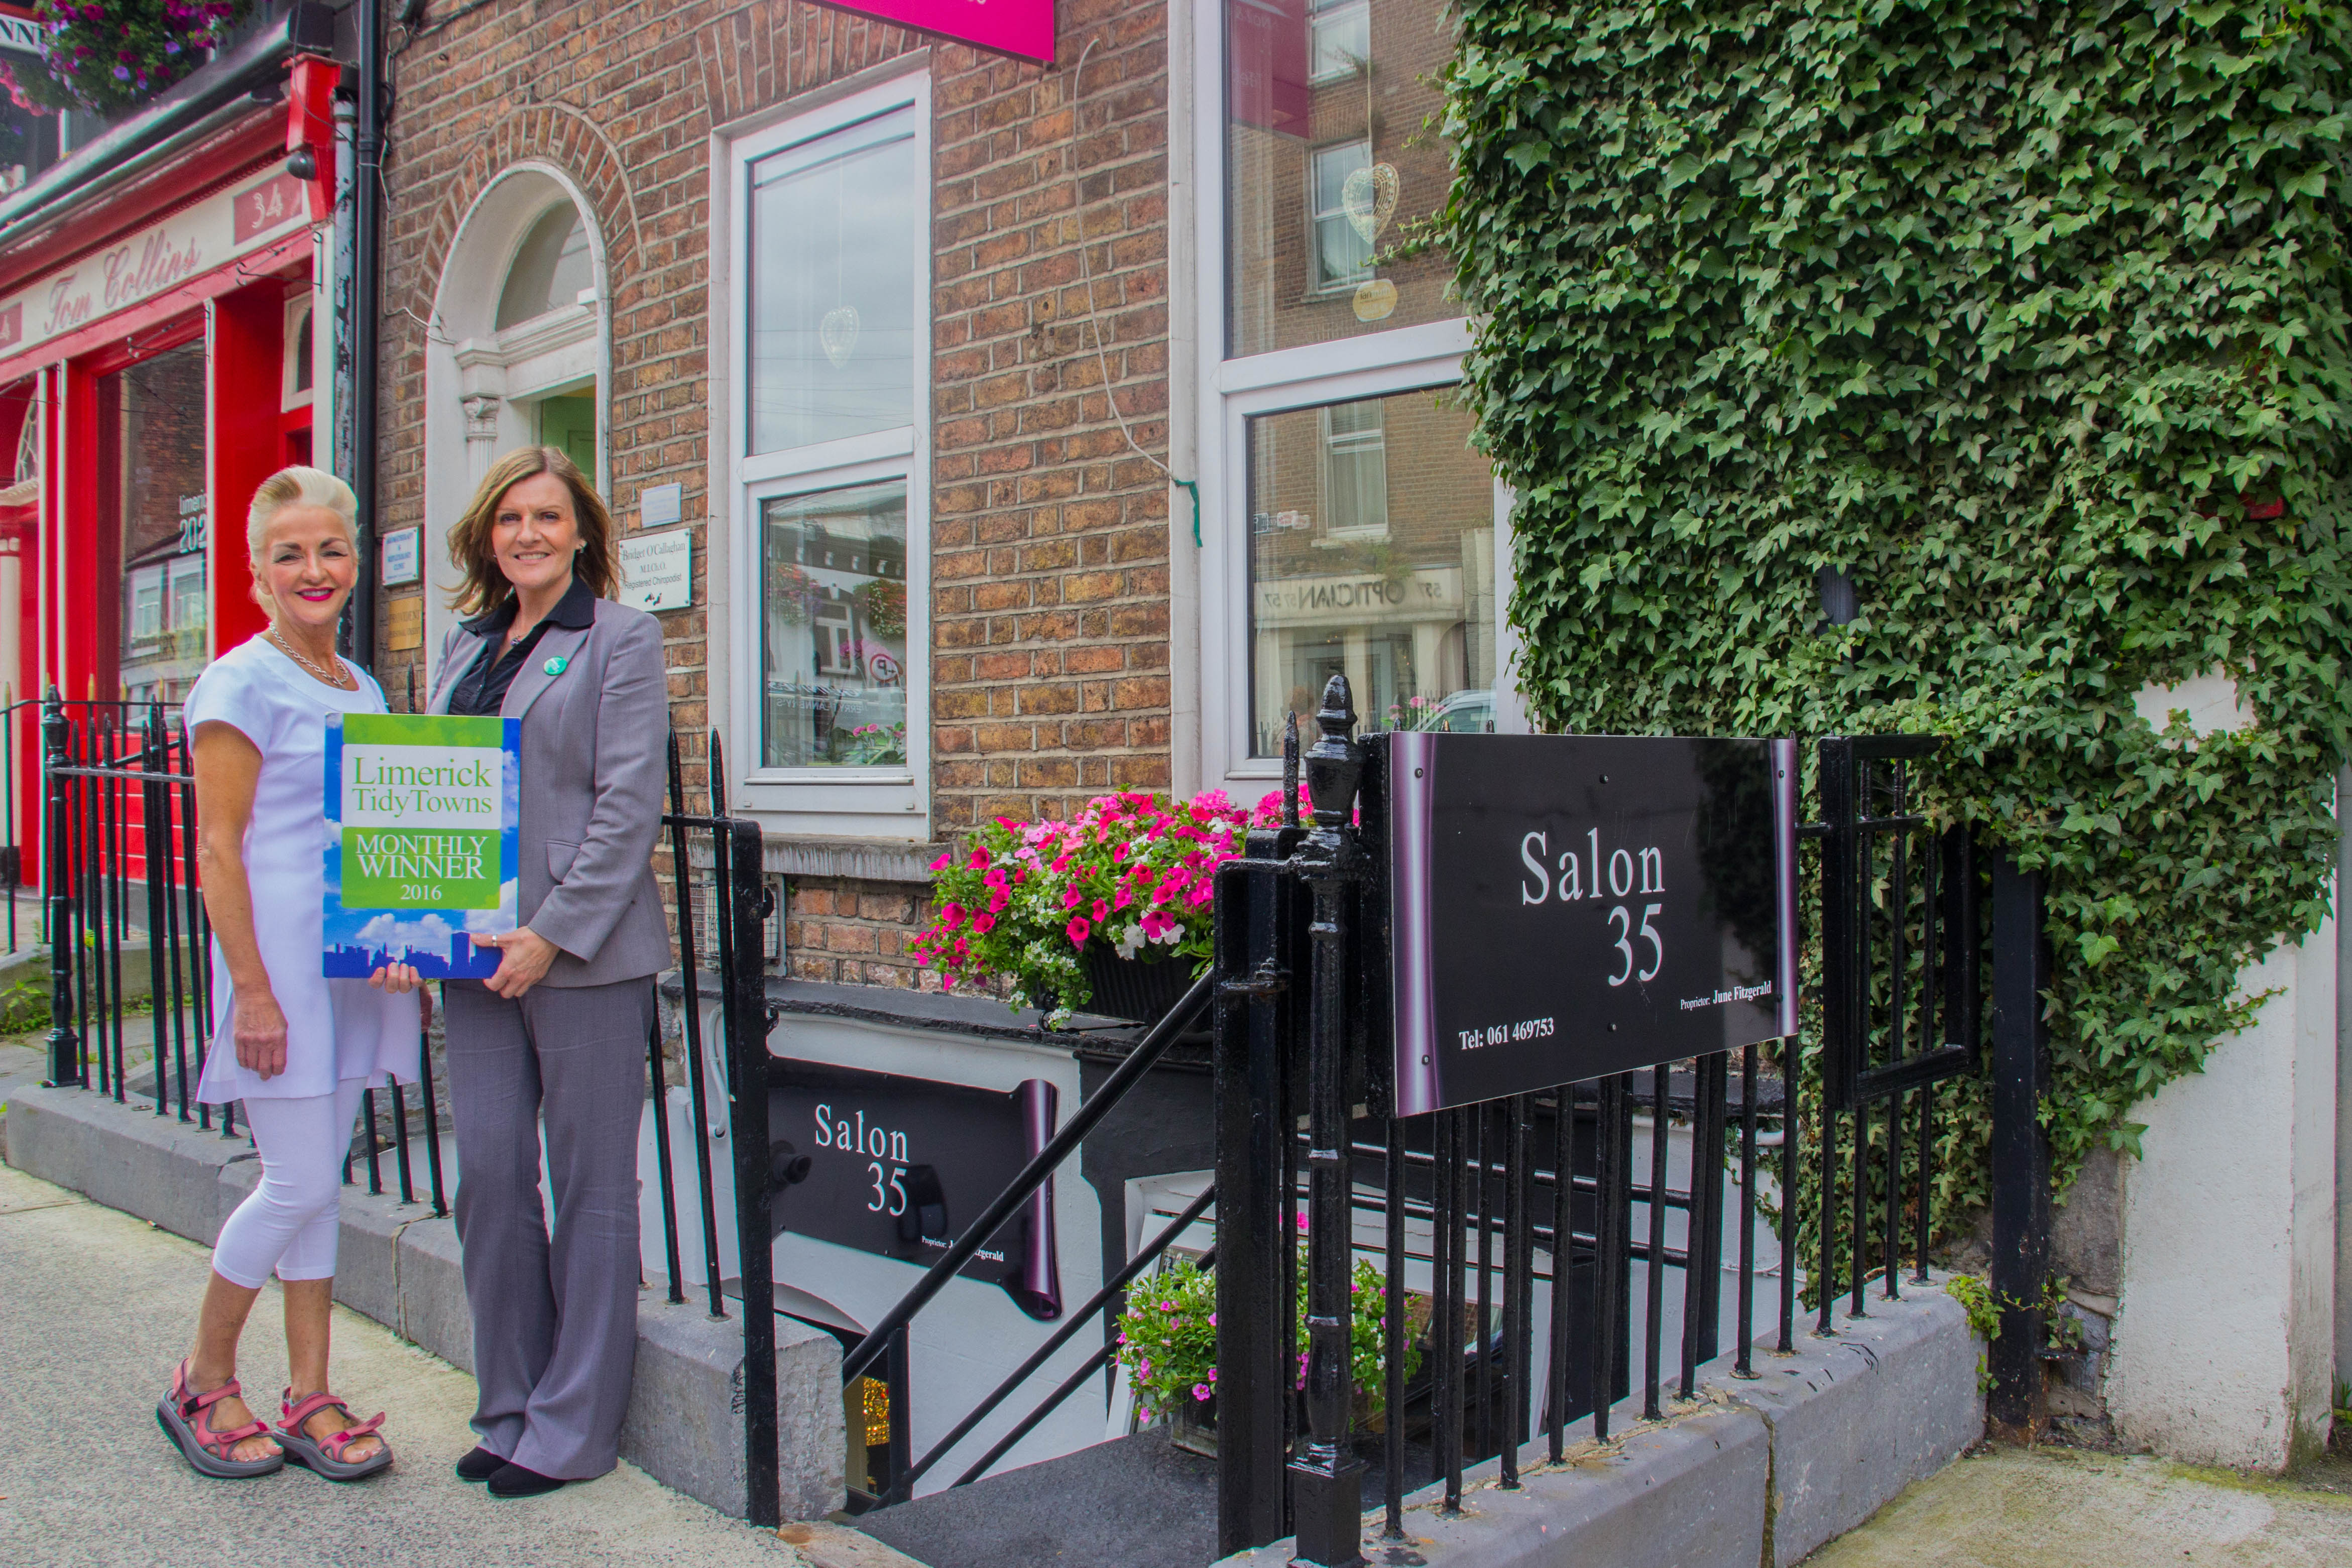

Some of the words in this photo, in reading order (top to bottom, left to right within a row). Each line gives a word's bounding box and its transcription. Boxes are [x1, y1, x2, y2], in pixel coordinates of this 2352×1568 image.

[251, 183, 284, 228] 34
[44, 271, 91, 334] Tom
[103, 229, 202, 309] Collins
[623, 548, 645, 561] Bridget
[647, 541, 685, 556] O'Callaghan
[624, 578, 652, 590] Registered
[653, 573, 682, 586] Chiropodist
[352, 756, 493, 787] Limerick
[356, 834, 489, 856] MONTHLY
[358, 855, 486, 879] WINNER
[1521, 827, 1666, 905] Salon
[400, 884, 442, 901] 2016
[1607, 904, 1662, 986] 35
[1680, 997, 1710, 1011] Proprietor:
[1713, 990, 1732, 1004] June
[1733, 980, 1771, 1001] Fitzgerald
[1459, 1029, 1483, 1050] Tel:
[1487, 1024, 1508, 1045] 061
[1512, 1017, 1554, 1041] 469753
[815, 1104, 909, 1163] Salon
[868, 1161, 907, 1217] 35
[921, 1235, 947, 1248] Proprietor:
